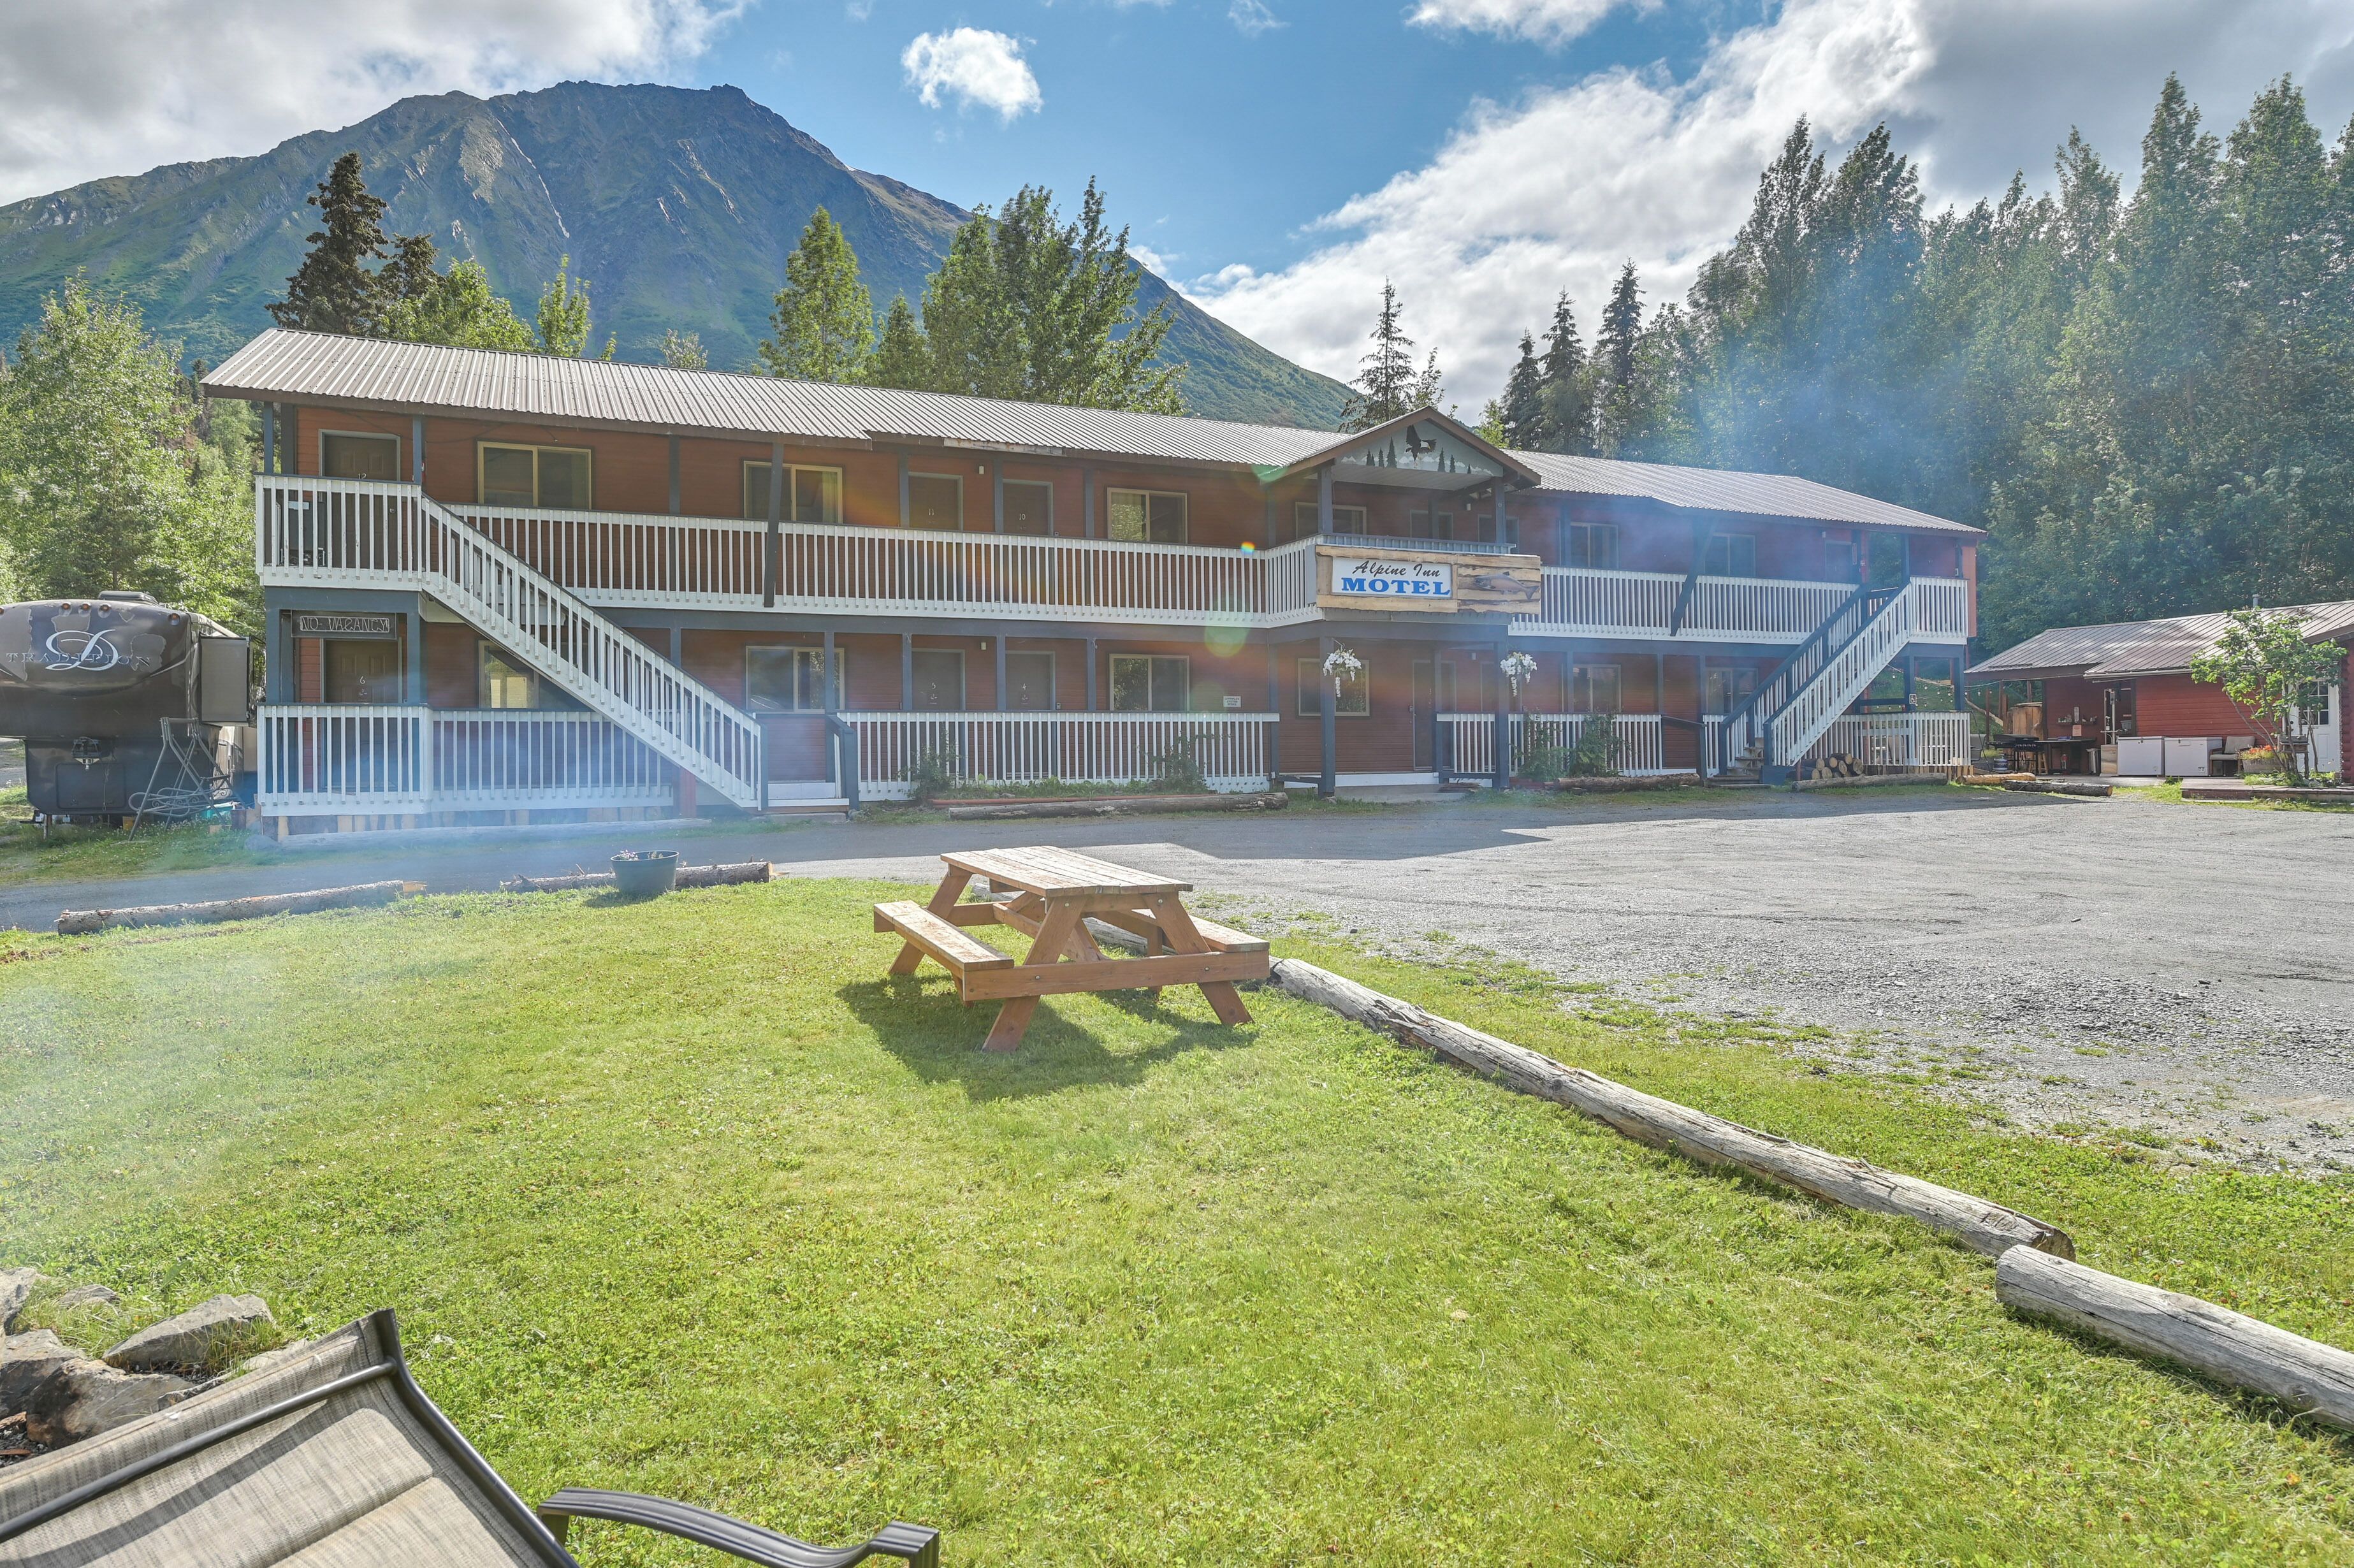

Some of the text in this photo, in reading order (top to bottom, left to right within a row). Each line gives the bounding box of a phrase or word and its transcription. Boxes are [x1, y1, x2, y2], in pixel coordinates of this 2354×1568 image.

[1352, 560, 1441, 577] Alpine Inn
[1341, 577, 1451, 595] MOTEL
[301, 616, 388, 632] NO VACANCY
[6, 652, 152, 667] TRADITION
[360, 676, 366, 685] 6
[1022, 683, 1027, 691] 4
